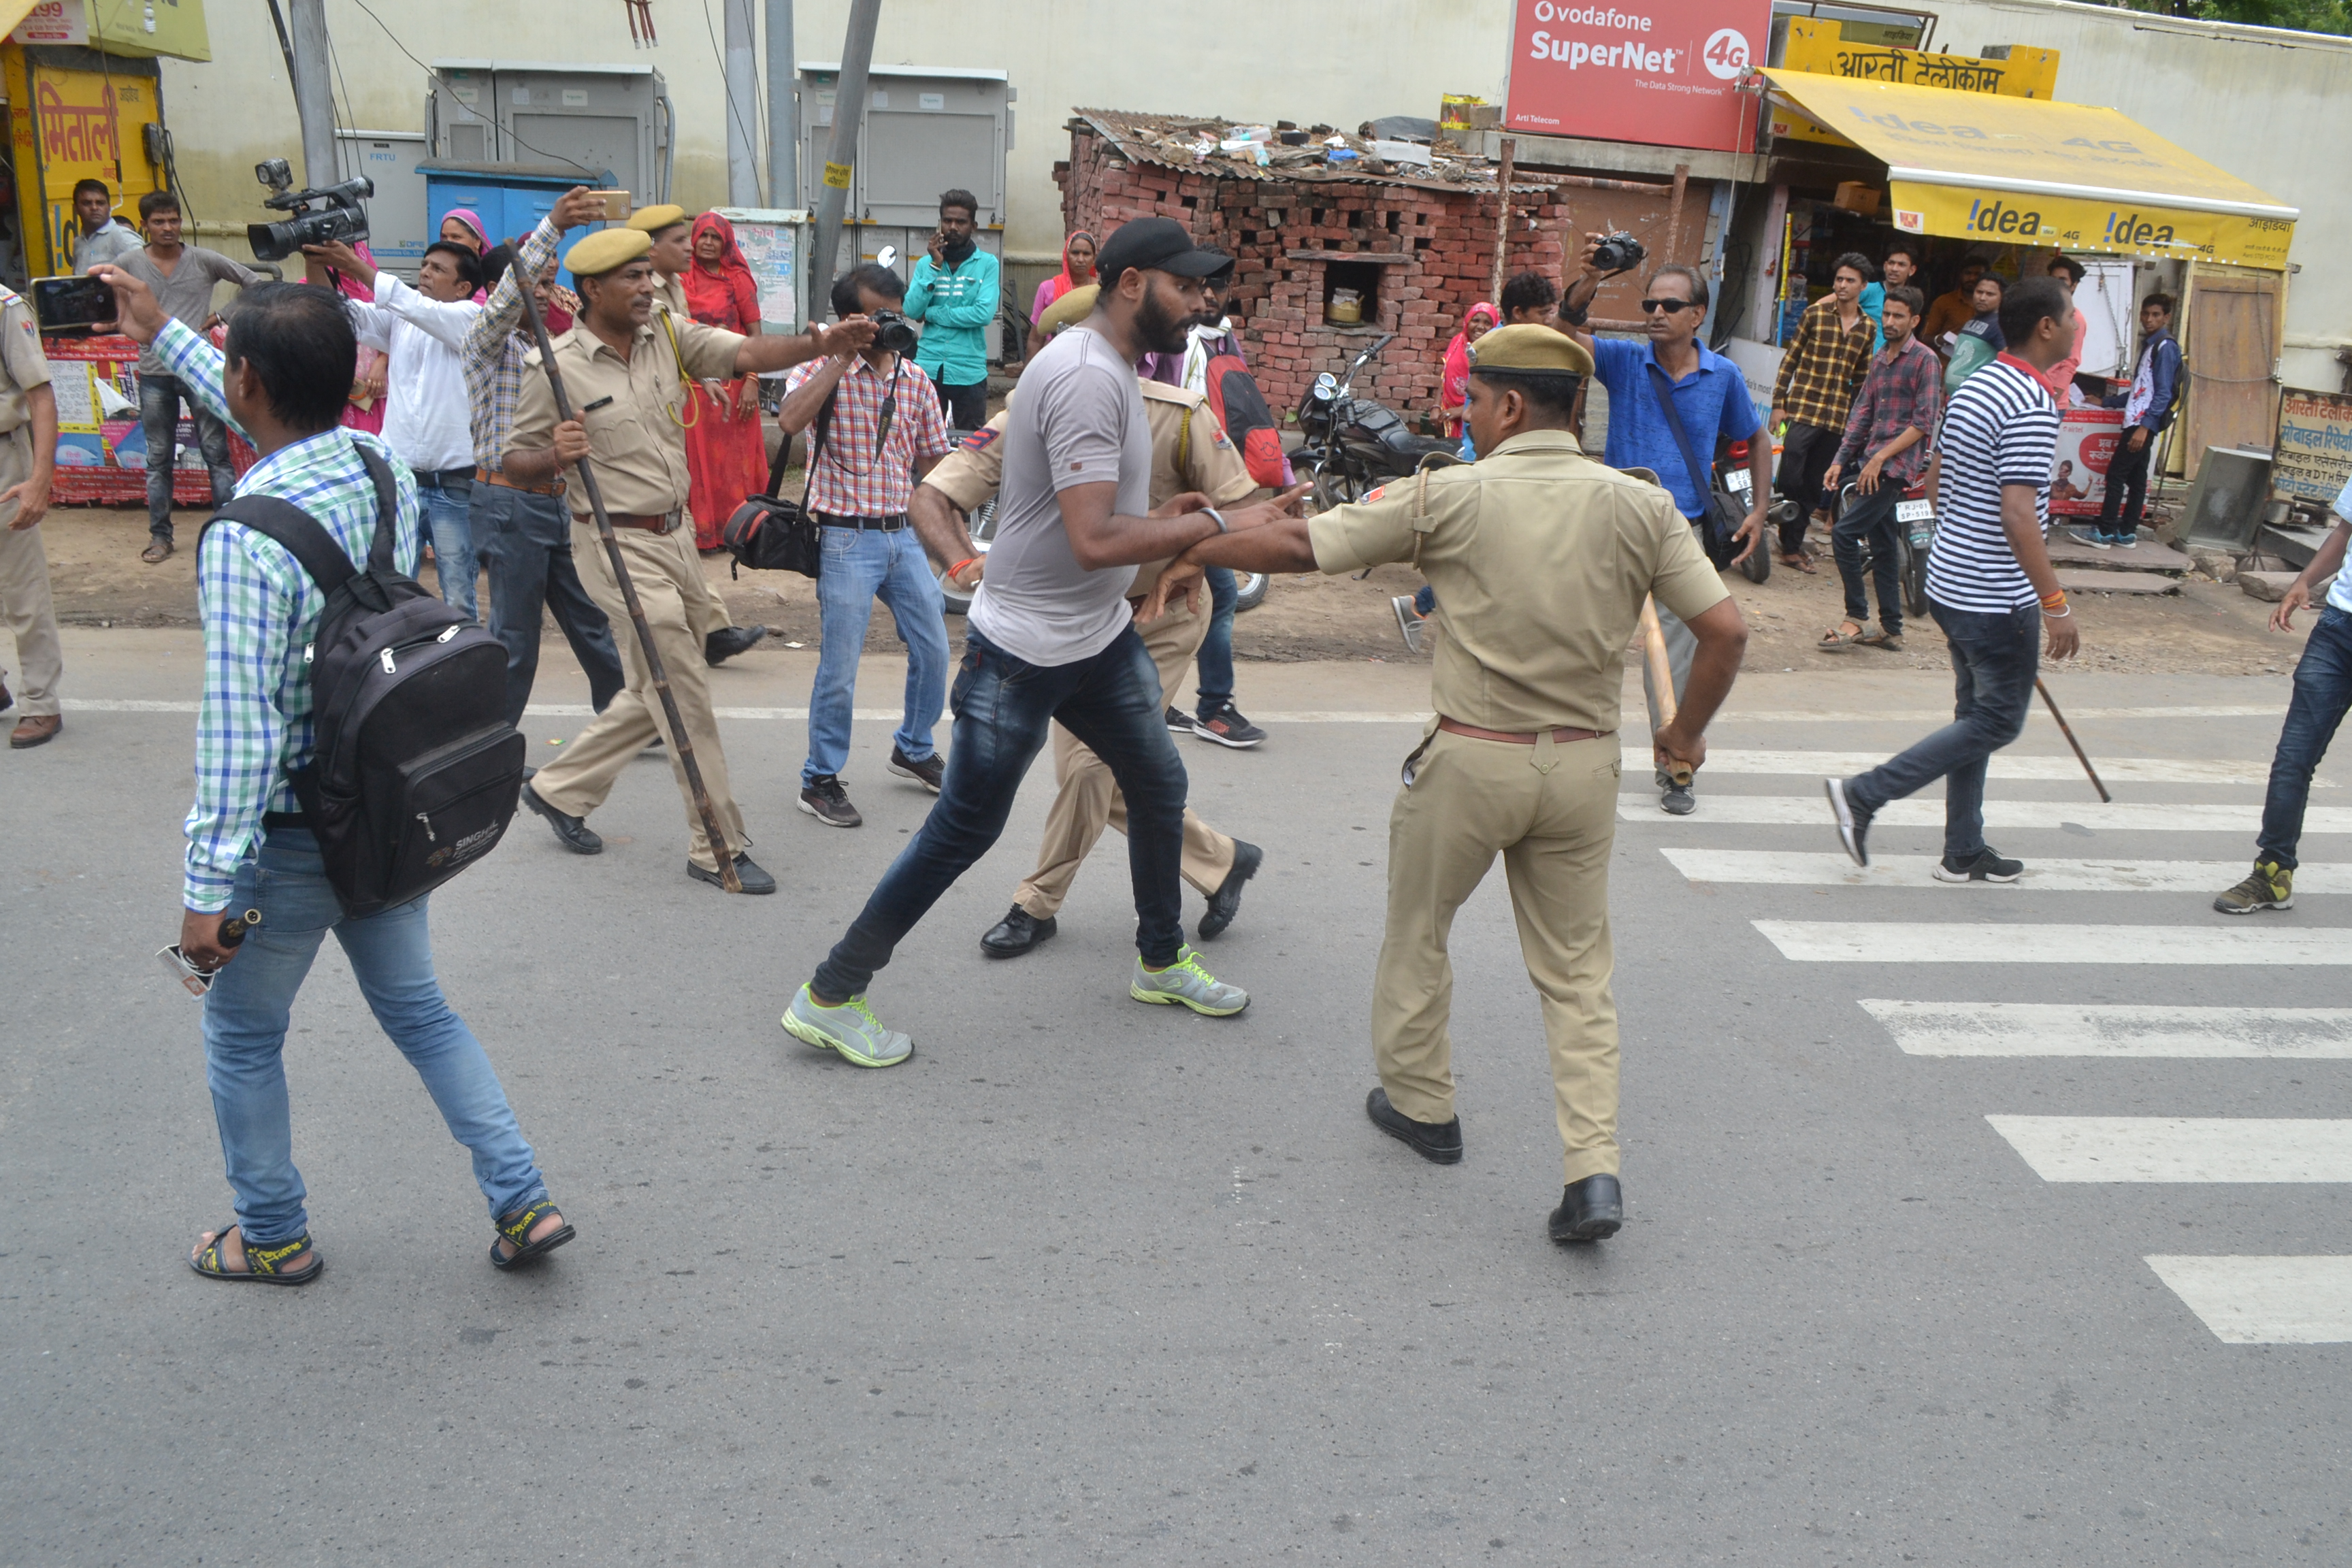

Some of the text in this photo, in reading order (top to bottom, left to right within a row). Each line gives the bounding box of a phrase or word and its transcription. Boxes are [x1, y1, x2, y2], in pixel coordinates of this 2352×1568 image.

[1556, 6, 1652, 32] vodafone
[1705, 35, 1745, 68] 4G
[1635, 79, 1648, 88] The
[1650, 80, 1667, 91] Data
[1667, 82, 1691, 95] Strong
[37, 80, 121, 163] मिताली
[1515, 114, 1560, 126] Arti Telecom
[2060, 136, 2142, 154] 4G
[369, 152, 397, 162] FRTU
[2062, 231, 2080, 240] 4G
[1757, 384, 1771, 395] most
[2281, 420, 2325, 449] मोबाइल
